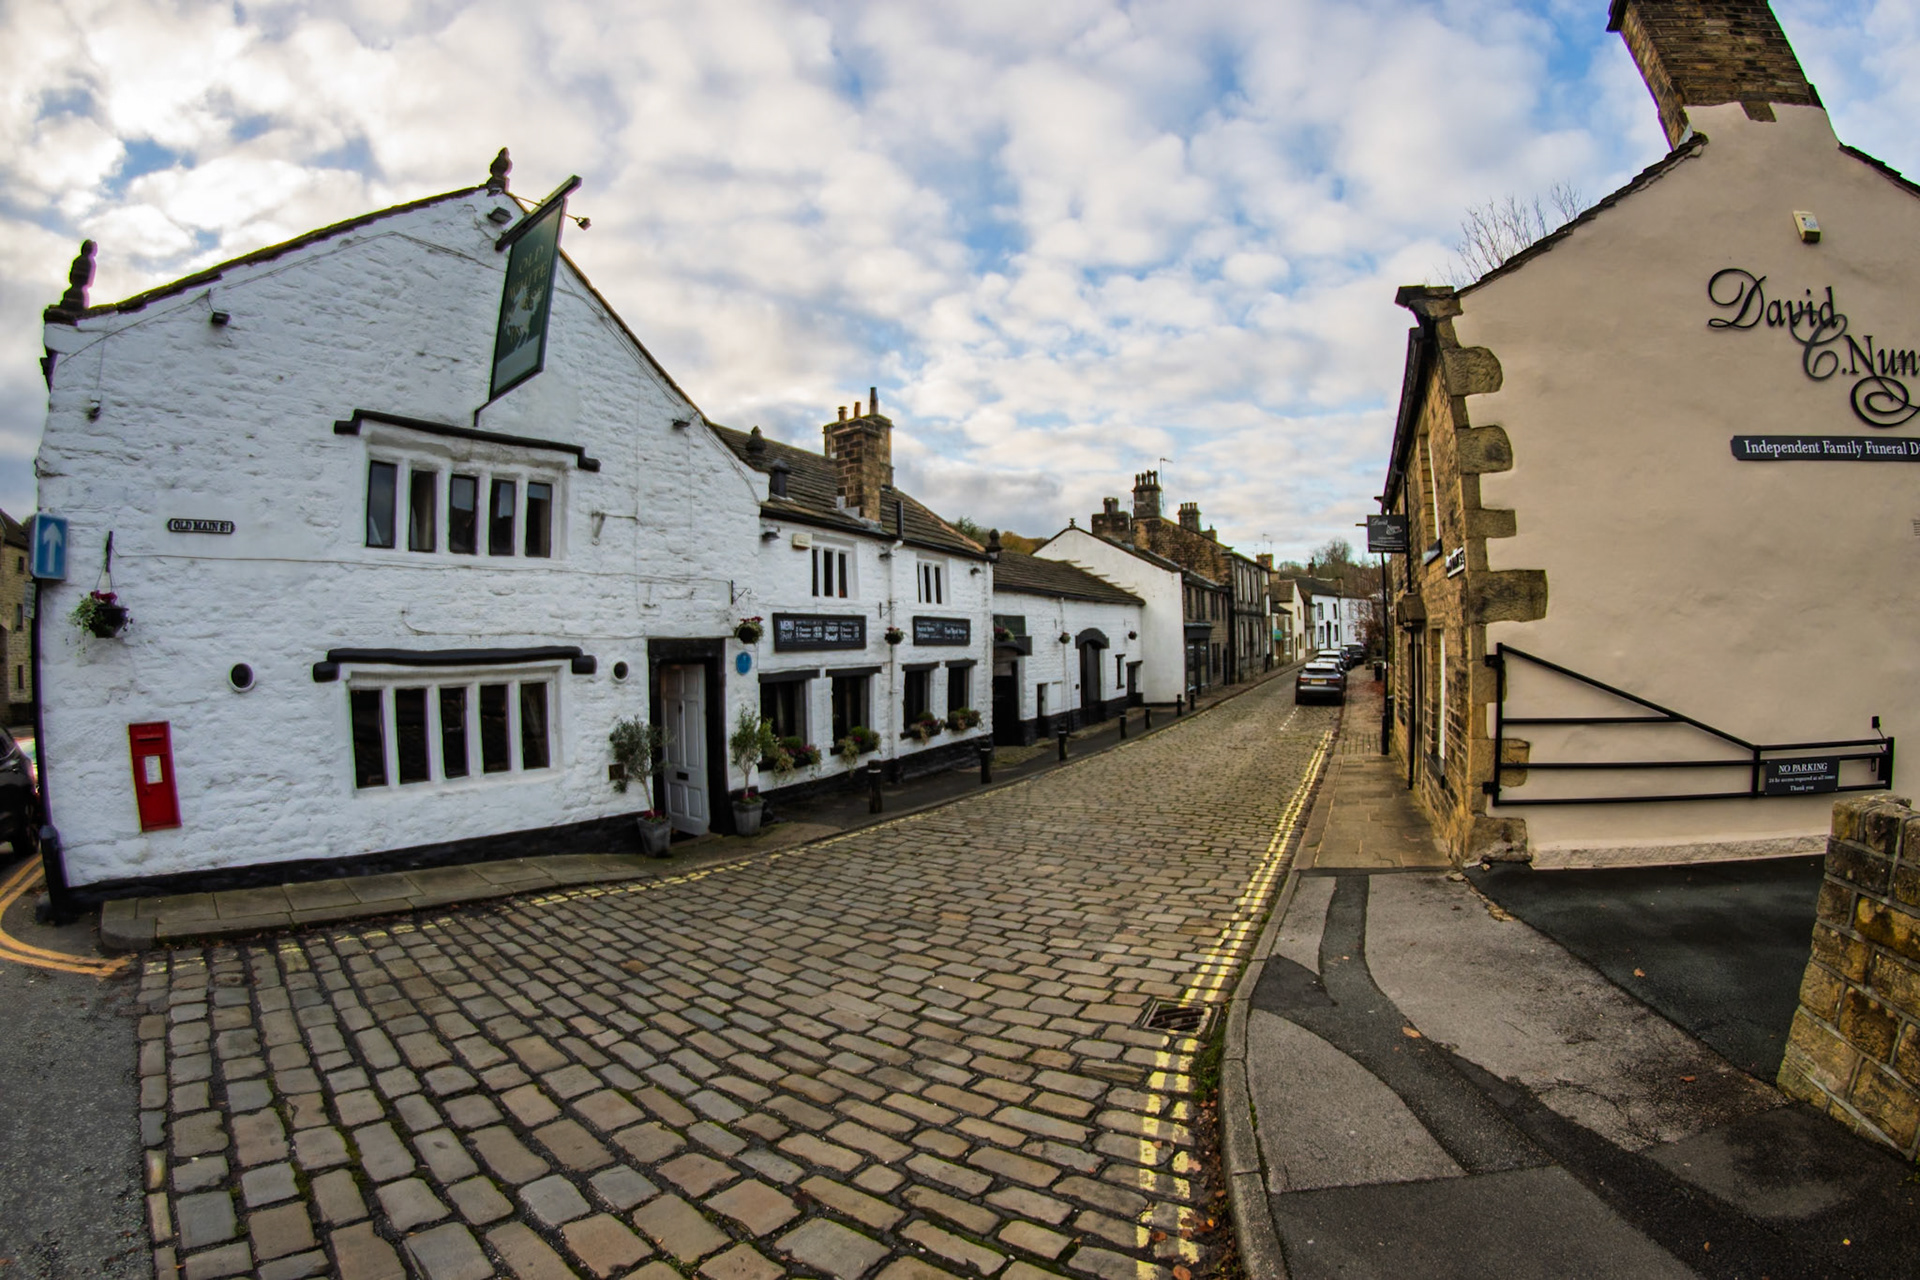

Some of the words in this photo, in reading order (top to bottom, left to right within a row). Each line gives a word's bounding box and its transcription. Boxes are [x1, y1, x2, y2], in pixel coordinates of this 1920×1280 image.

[1708, 268, 1838, 328] David
[1744, 440, 1820, 458] Independent
[1822, 440, 1862, 459] Family
[1864, 440, 1908, 455] Funeral
[173, 520, 192, 531] OLD
[193, 520, 219, 532] MAIN
[1778, 764, 1791, 773] NO
[1792, 762, 1828, 772] PARKING
